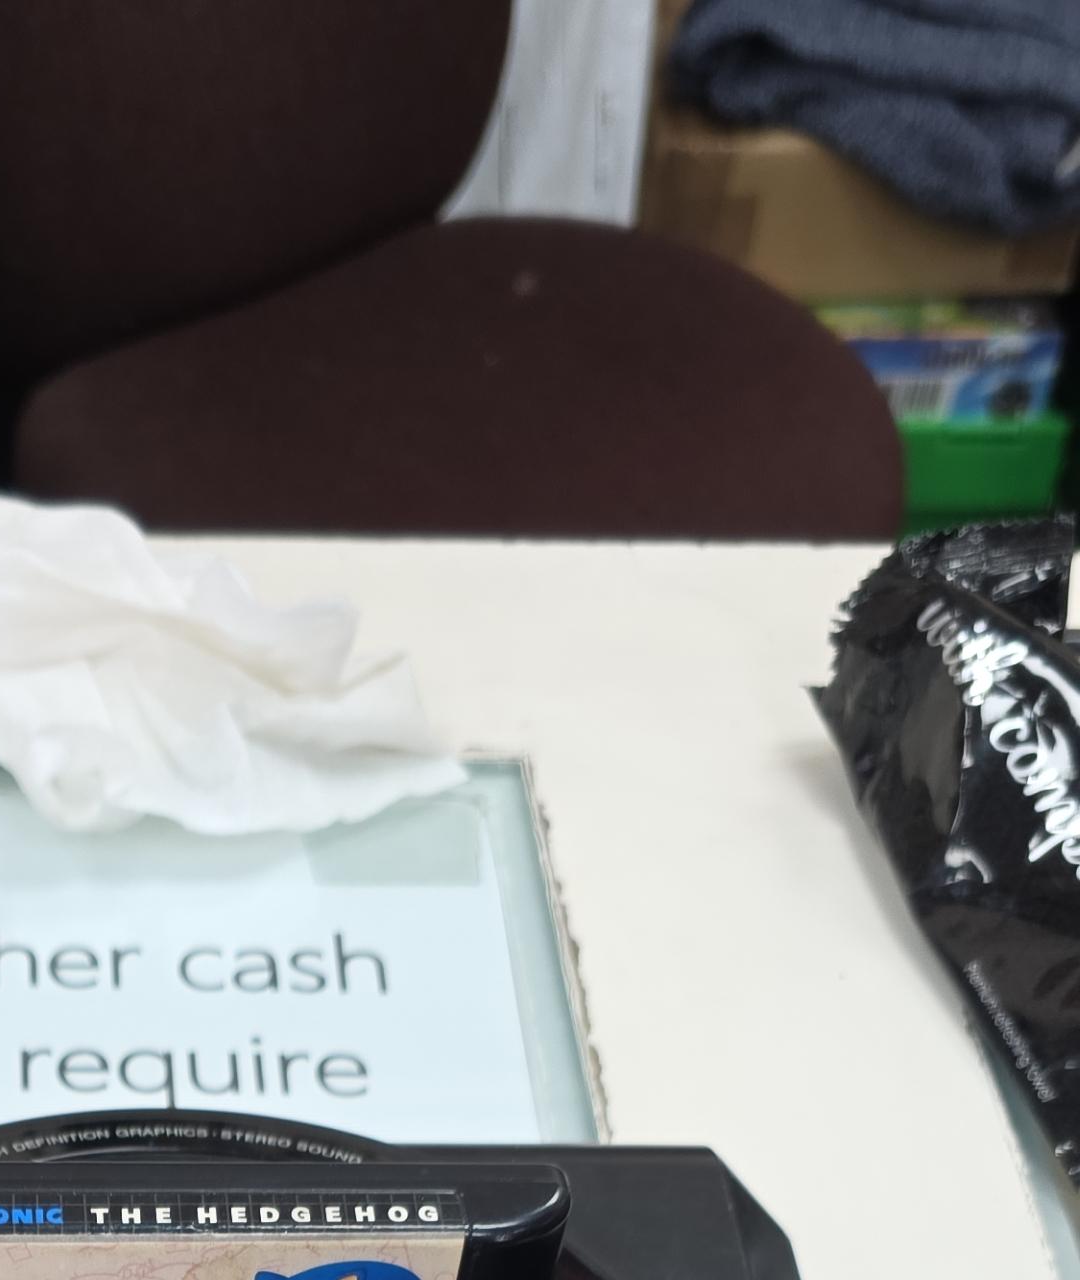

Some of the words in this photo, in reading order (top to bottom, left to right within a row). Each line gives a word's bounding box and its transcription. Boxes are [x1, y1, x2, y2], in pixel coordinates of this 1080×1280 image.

[917, 600, 1028, 706] with
[989, 716, 1080, 881] comp
[178, 932, 390, 996] cash
[18, 1034, 370, 1109] require
[12, 1128, 111, 1154] DEFINITION
[115, 1125, 209, 1139] GRAPHICS
[220, 1129, 292, 1149] STEREO
[295, 1139, 364, 1164] SOUND
[90, 1207, 173, 1225] THE
[196, 1205, 440, 1225] HEDGEHOG
